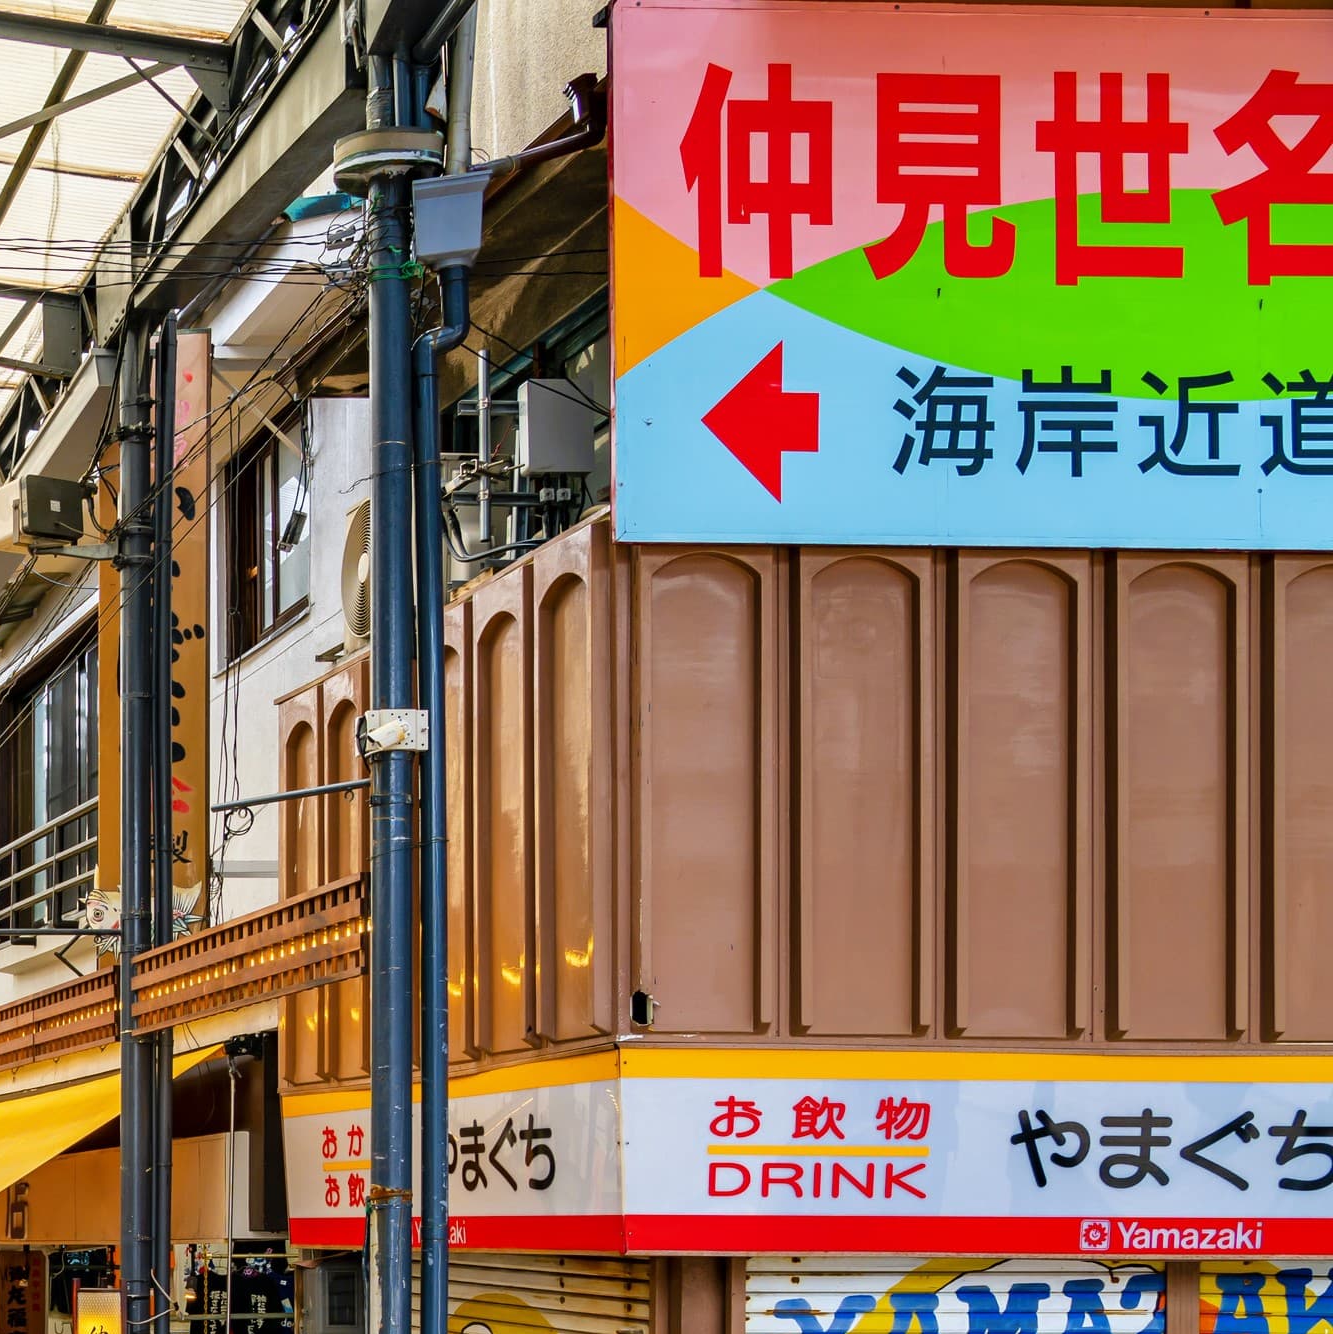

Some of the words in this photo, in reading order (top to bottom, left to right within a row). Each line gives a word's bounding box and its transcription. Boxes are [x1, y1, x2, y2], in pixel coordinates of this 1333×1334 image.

[680, 61, 1333, 286] 仲見世名
[892, 365, 1333, 479] 海岸近道
[709, 1096, 931, 1140] お飲物
[322, 1123, 364, 1159] おか
[1010, 1107, 1333, 1192] やまぐち
[324, 1172, 366, 1208] お飲
[707, 1162, 928, 1200] DRINK
[1117, 1220, 1263, 1252] Yamazaki
